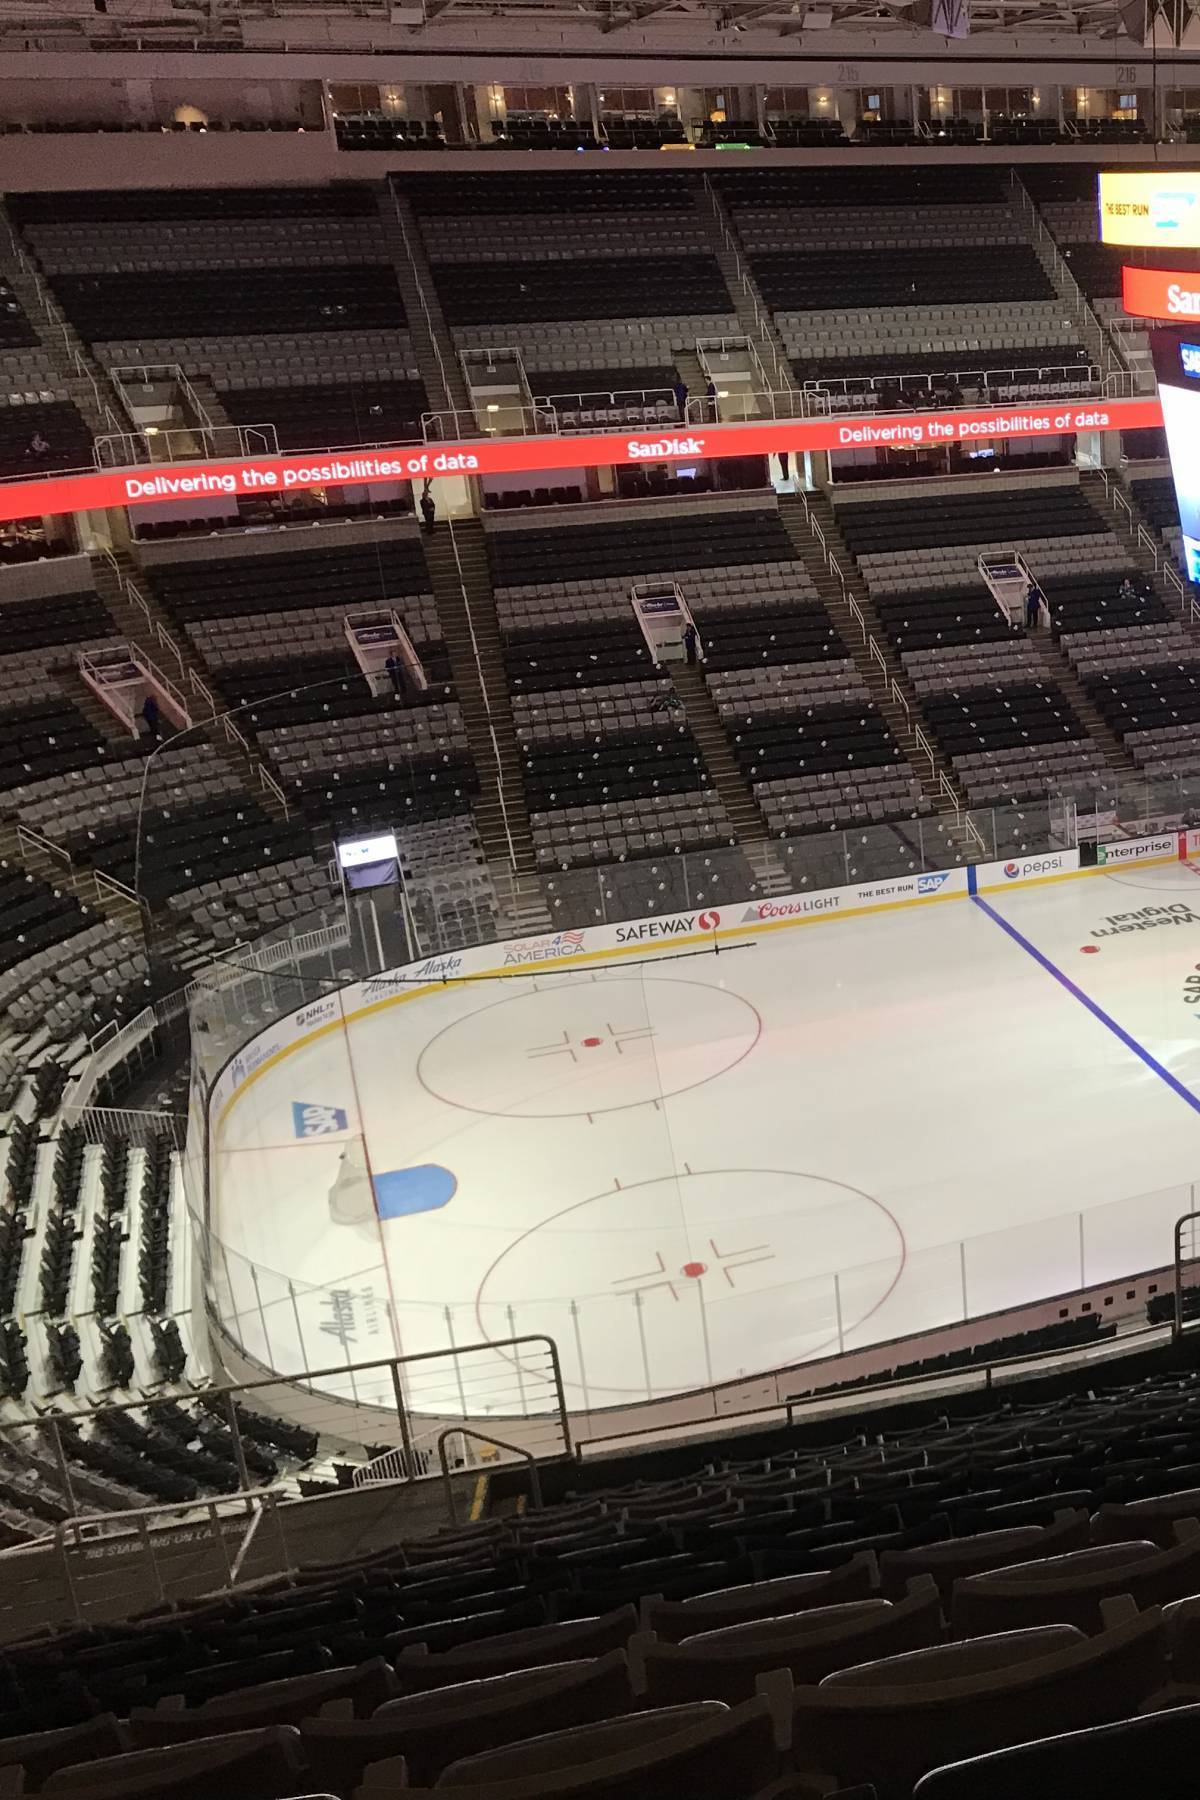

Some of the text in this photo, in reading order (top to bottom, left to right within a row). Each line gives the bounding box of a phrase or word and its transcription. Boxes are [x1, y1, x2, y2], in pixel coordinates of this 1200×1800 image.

[1118, 66, 1136, 83] 216
[1115, 203, 1131, 216] BEST
[1132, 203, 1149, 216] RUN
[839, 410, 1110, 444] Delivering the possibilities of data
[627, 438, 705, 459] SanDisk
[125, 452, 479, 498] Delivering the possibilities of data
[1023, 855, 1063, 876] pepsi
[858, 884, 914, 899] THE BEST RUN
[918, 877, 943, 892] SAP
[757, 896, 840, 920] Coors LIGHT
[1098, 903, 1192, 926] Digital
[616, 917, 696, 943] SAFEWAY
[503, 935, 562, 953] SOLAR 4
[503, 943, 586, 966] AMERICA
[414, 955, 463, 978] Alaska
[301, 1104, 339, 1137] SAP
